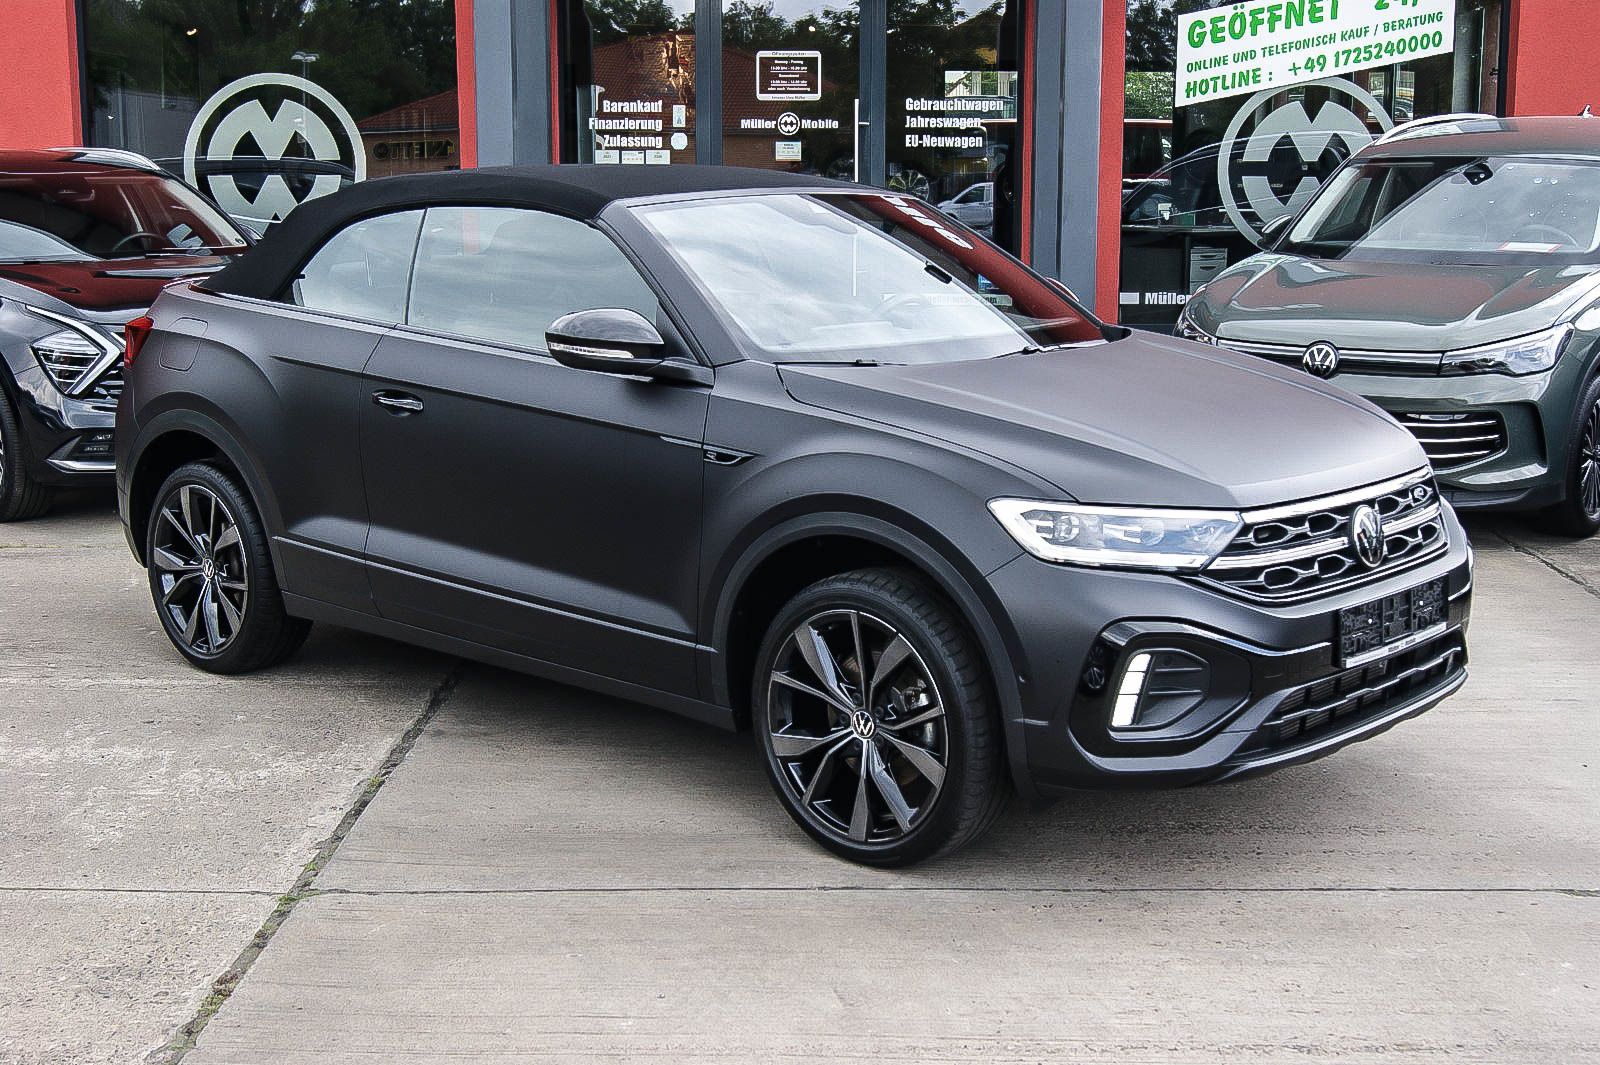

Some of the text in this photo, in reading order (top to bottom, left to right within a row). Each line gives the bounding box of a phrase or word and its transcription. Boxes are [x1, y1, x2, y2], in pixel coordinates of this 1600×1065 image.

[1188, 0, 1338, 48] GEÖFFNET
[1186, 55, 1229, 73] ONLINE
[1233, 49, 1257, 64] UND
[1261, 33, 1336, 58] TELEFONISCH
[1340, 26, 1370, 42] KAUF
[1383, 11, 1444, 32] BERATUNG
[1185, 68, 1262, 98] HOTLINE
[1287, 54, 1327, 76] +49
[1334, 30, 1443, 67] 1725240000
[602, 99, 663, 113] Barankauf
[905, 97, 1004, 112] Gebrauchtwagen
[588, 117, 663, 132] Finanzierung
[740, 118, 777, 129] Müller
[801, 118, 839, 129] Mobile
[905, 115, 981, 129] Jahreswagen
[603, 134, 663, 149] Zulassung
[905, 134, 983, 149] EU-Neuwagen
[1144, 291, 1193, 305] Müller
